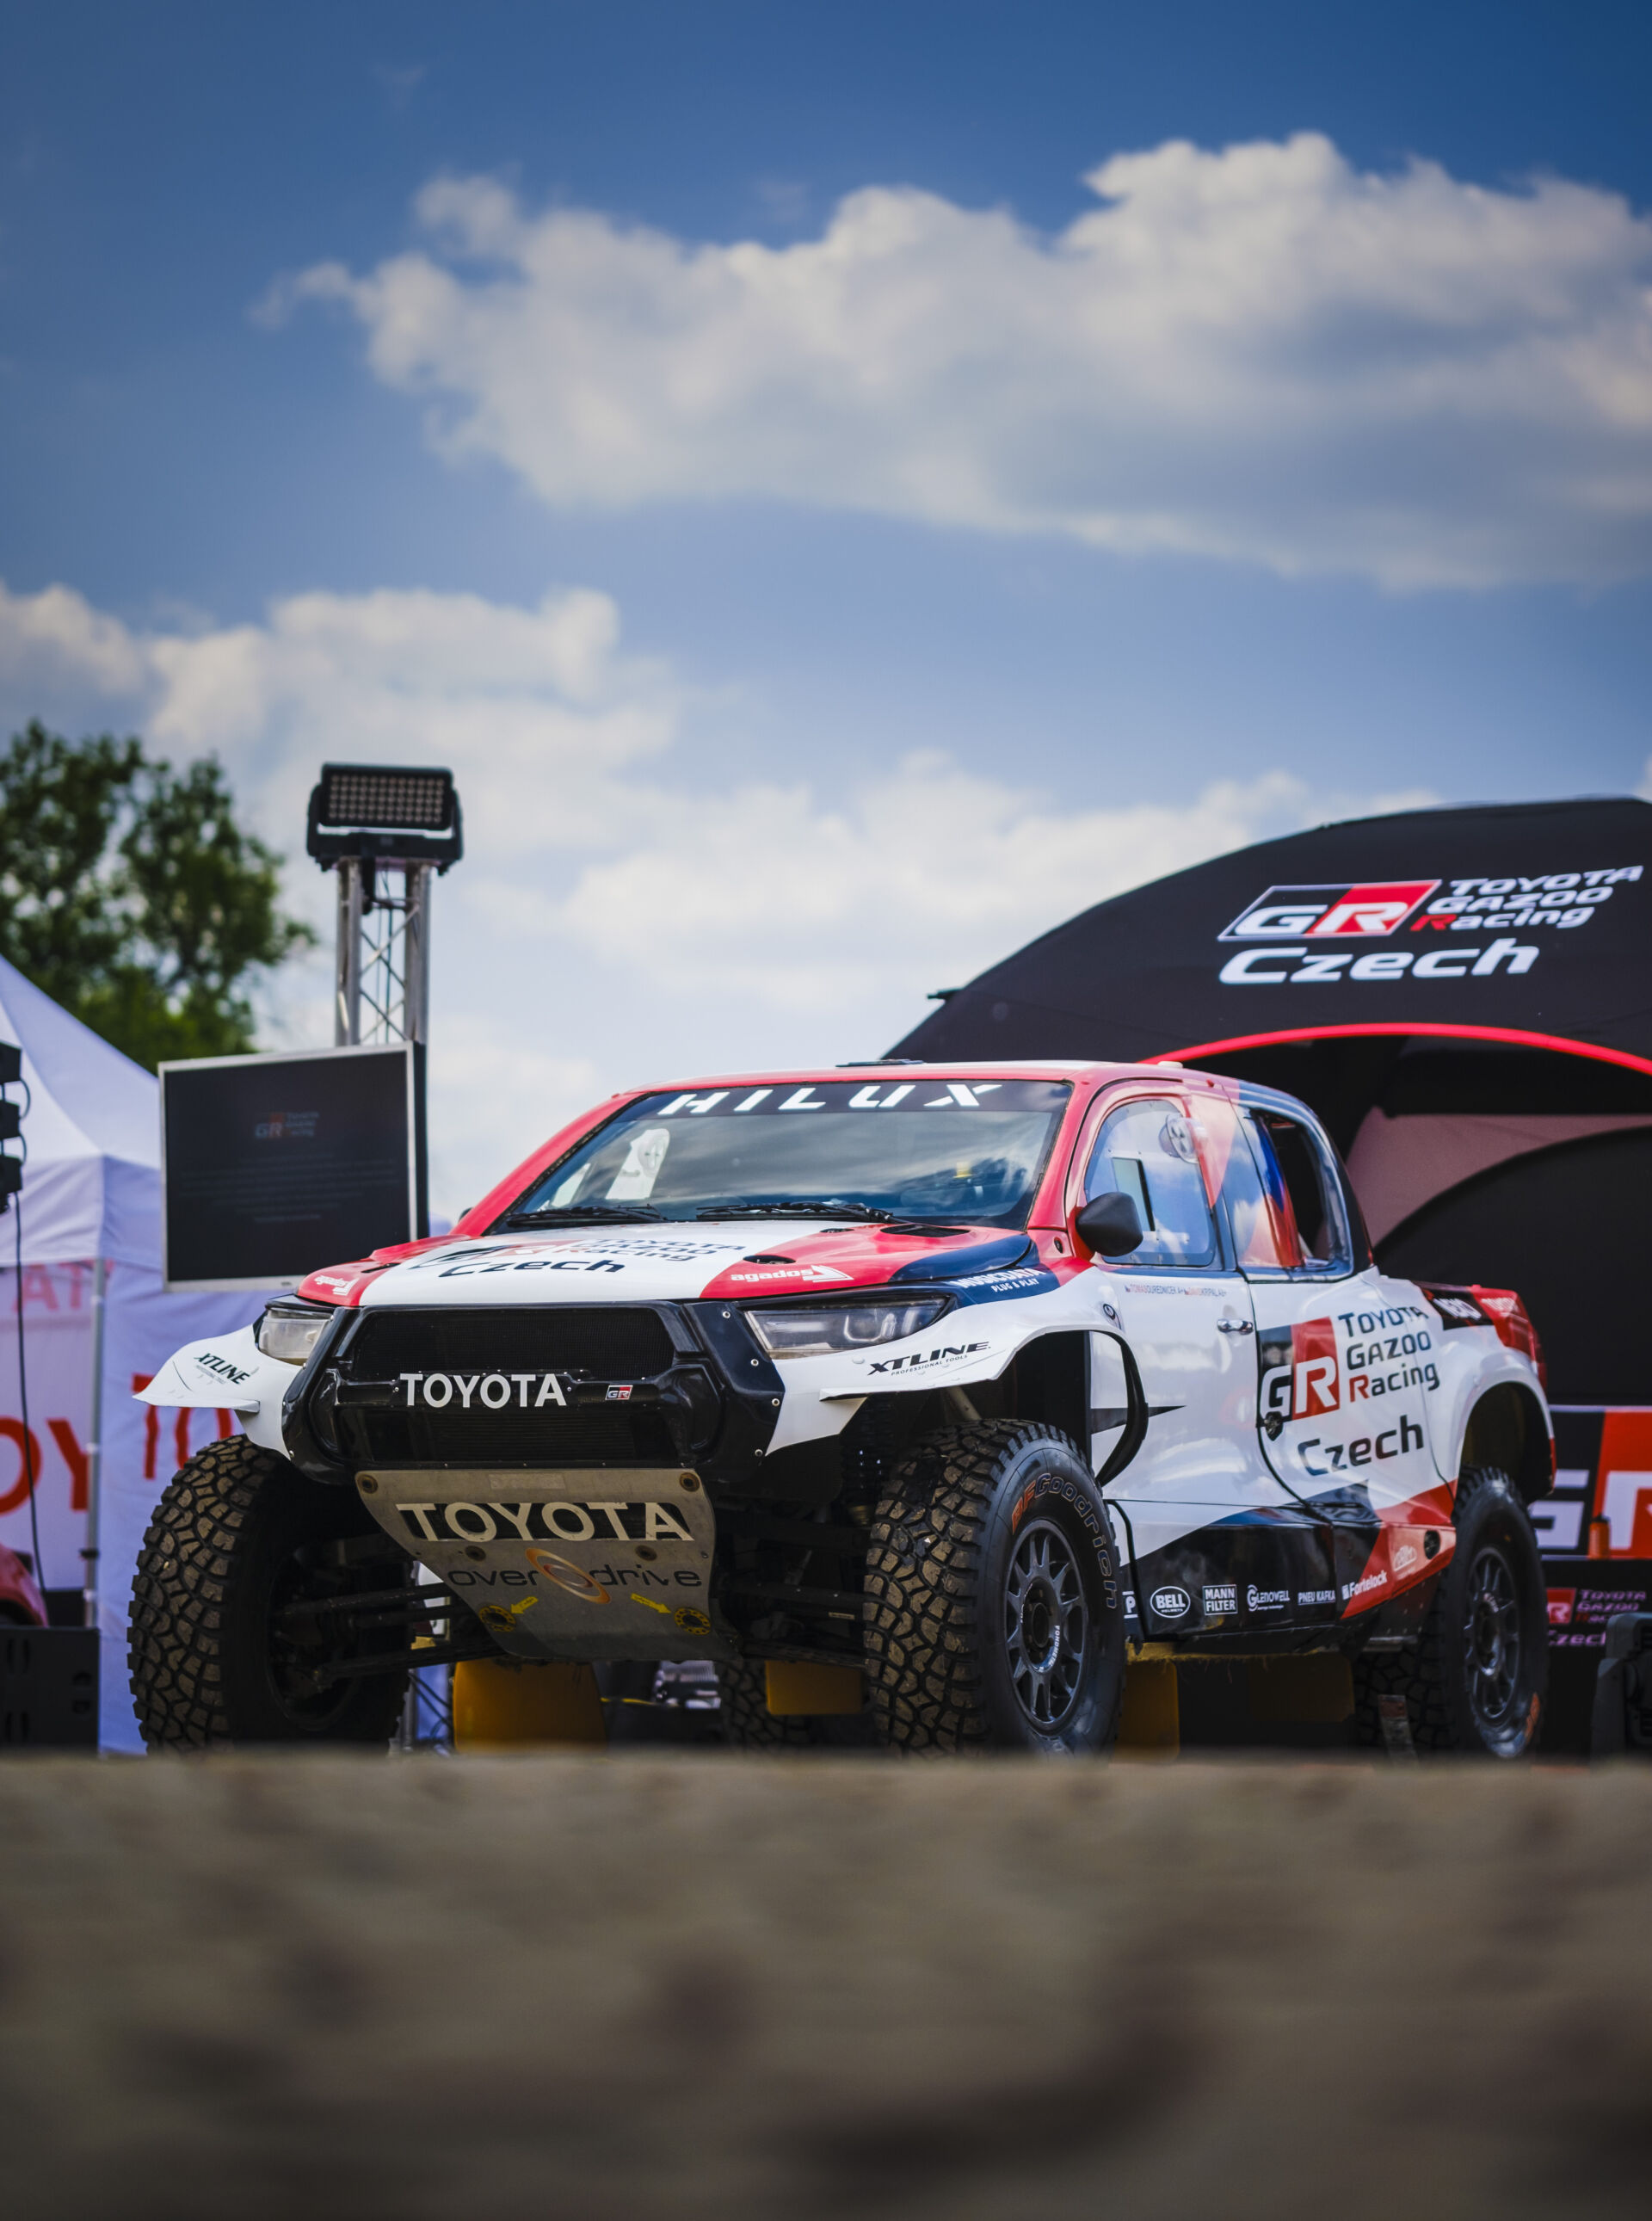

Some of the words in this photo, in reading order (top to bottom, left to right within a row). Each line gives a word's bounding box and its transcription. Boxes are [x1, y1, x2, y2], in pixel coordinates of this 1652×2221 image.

[1450, 865, 1643, 896] TOYOTA
[1234, 901, 1409, 936] GR
[1427, 886, 1614, 915] GAZOO
[1409, 907, 1595, 932] Racing
[1218, 937, 1540, 985] Czech
[656, 1084, 1003, 1116] HILUX
[598, 1239, 747, 1250] TOYOTA
[438, 1259, 626, 1278] Czech
[730, 1269, 814, 1282] agados
[990, 1283, 1014, 1292] PLUG
[1019, 1278, 1039, 1287] PLAY
[1338, 1306, 1429, 1338] TOYOTA
[867, 1341, 989, 1376] XTLINE
[891, 1360, 943, 1377] PROFESSIONAL
[946, 1354, 968, 1364] TOOLS
[1347, 1331, 1432, 1371] GAZOO
[194, 1353, 250, 1385] XTLINE
[399, 1373, 567, 1410] TOYOTA
[607, 1390, 630, 1400] GR
[1259, 1355, 1337, 1420] GR
[1349, 1362, 1440, 1403] Racing
[1297, 1414, 1424, 1477] Czech
[396, 1502, 695, 1542] TOYOTA
[447, 1569, 540, 1587] over
[589, 1564, 702, 1587] drive
[1156, 1593, 1186, 1609] BELL
[1205, 1588, 1236, 1600] MANN
[1206, 1600, 1236, 1612] FILTER
